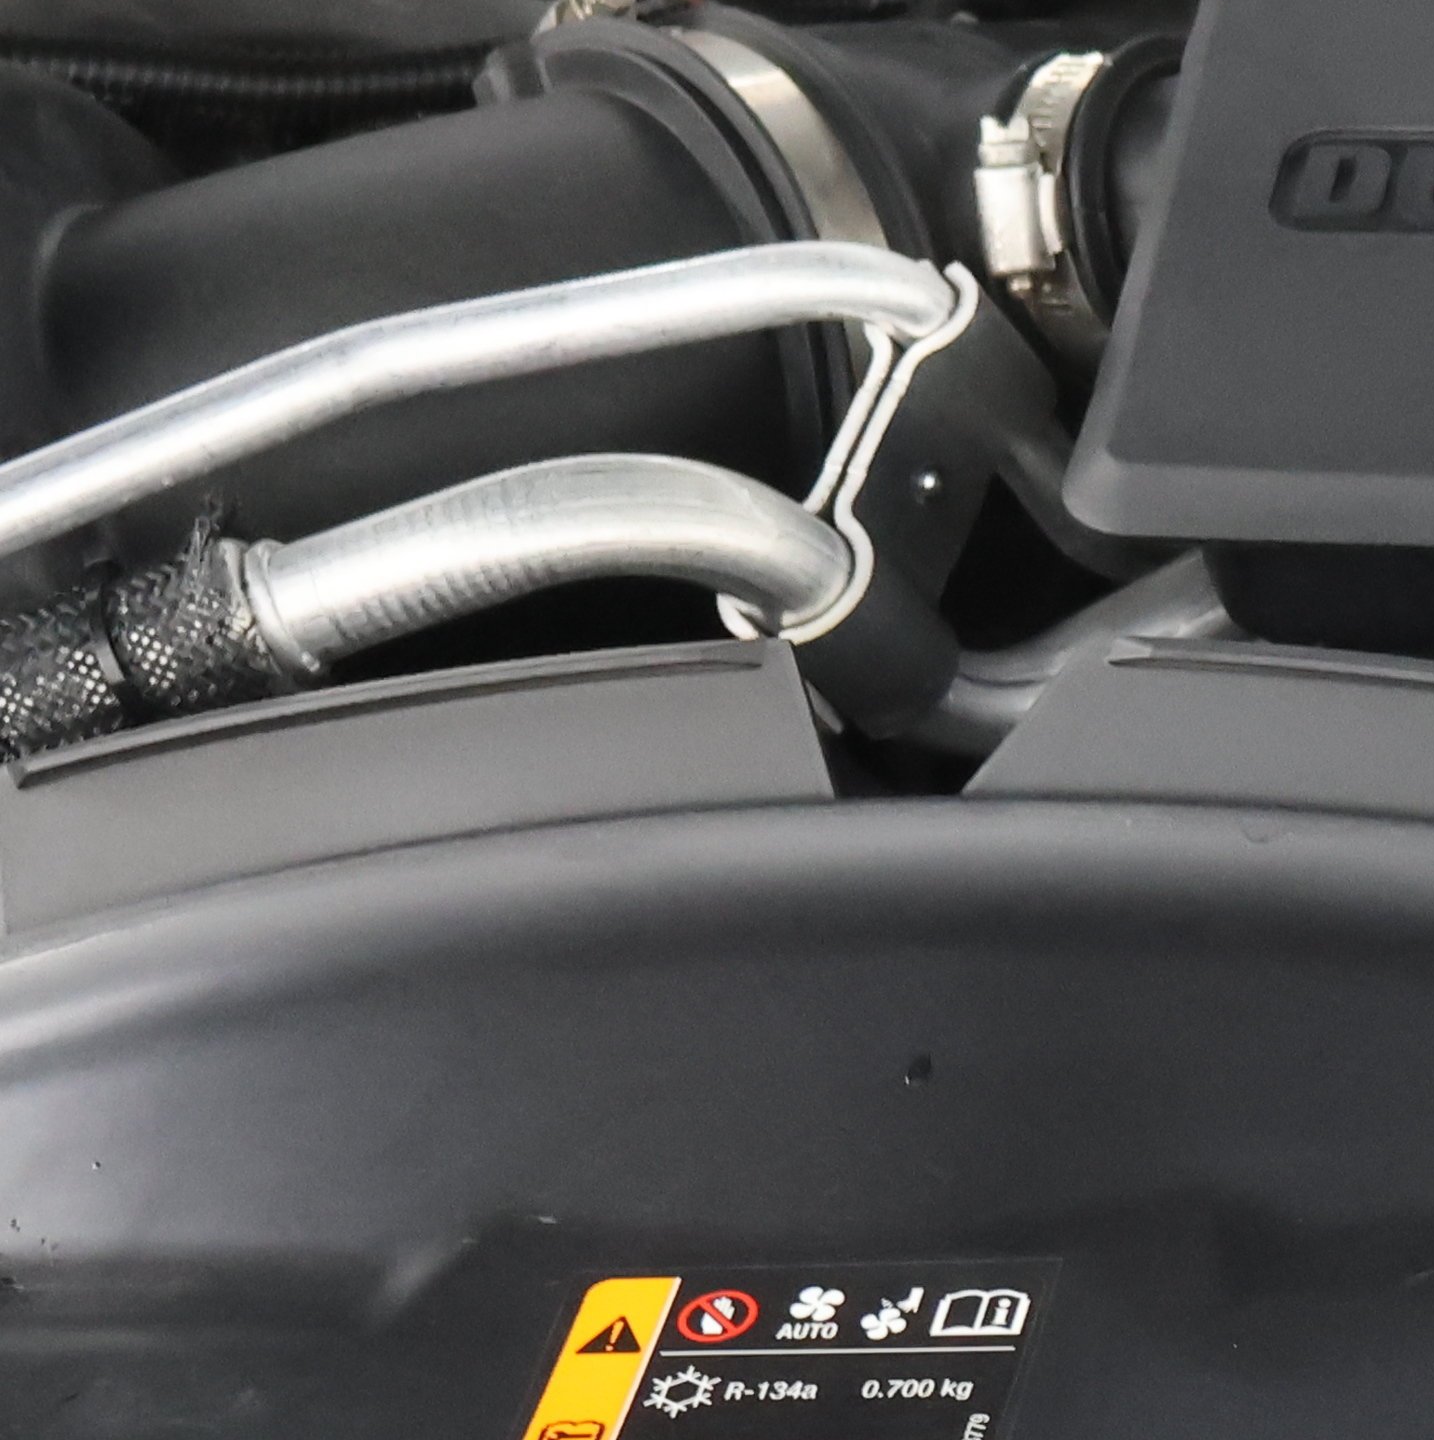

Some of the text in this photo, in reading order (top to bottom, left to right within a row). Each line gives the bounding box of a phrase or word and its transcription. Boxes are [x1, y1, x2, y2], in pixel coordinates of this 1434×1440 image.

[776, 1322, 839, 1341] AUTO
[723, 1377, 974, 1401] R-134a 0.700 kg
